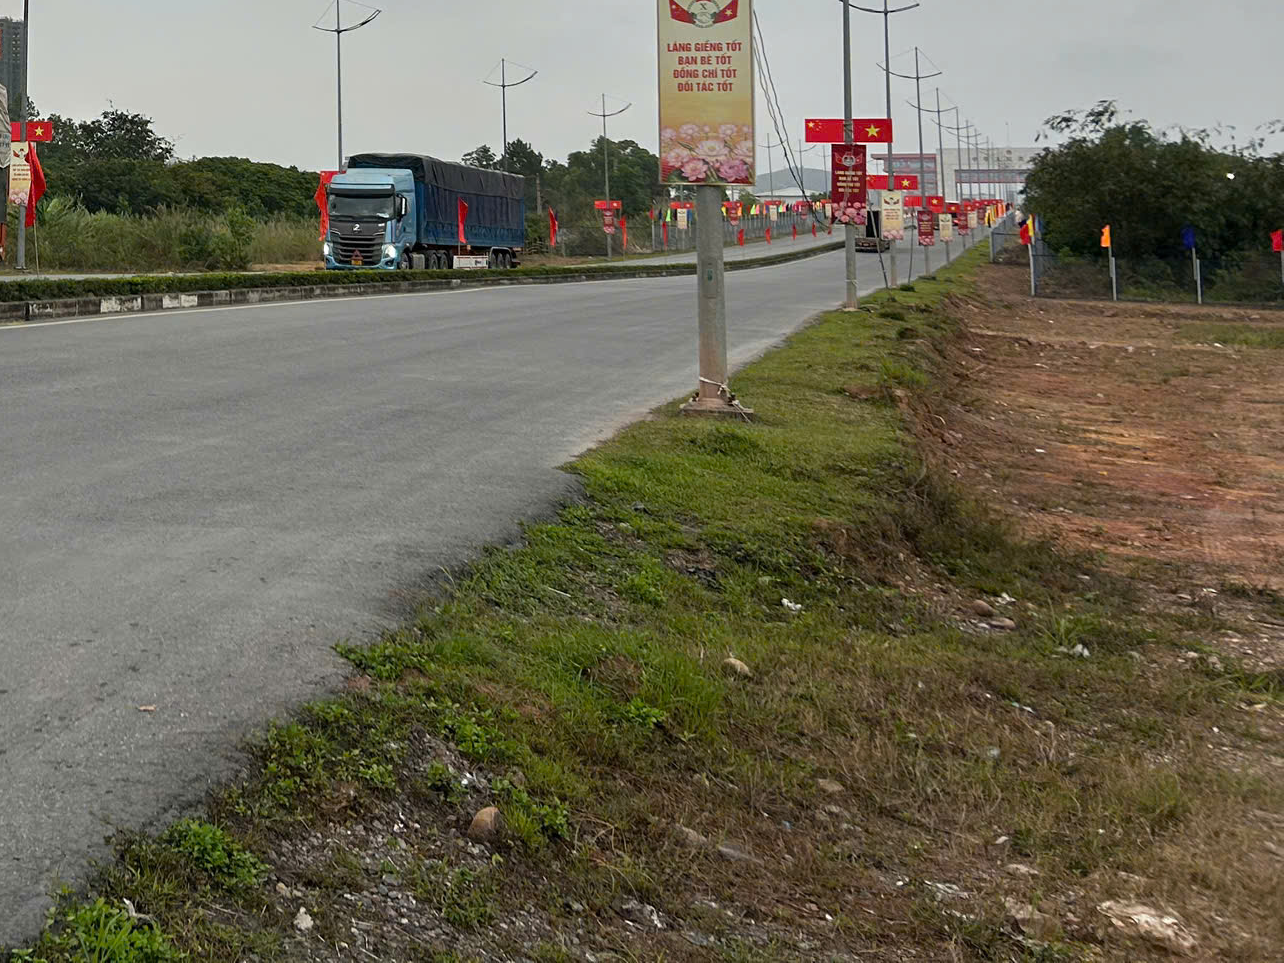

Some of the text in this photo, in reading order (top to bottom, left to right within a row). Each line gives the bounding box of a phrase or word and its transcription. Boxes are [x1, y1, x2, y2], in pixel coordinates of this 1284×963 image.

[725, 39, 742, 52] TỐT
[677, 55, 698, 68] BẠN
[715, 53, 732, 65] TỐT
[720, 66, 737, 78] TỐT
[716, 79, 733, 92] TỐT
